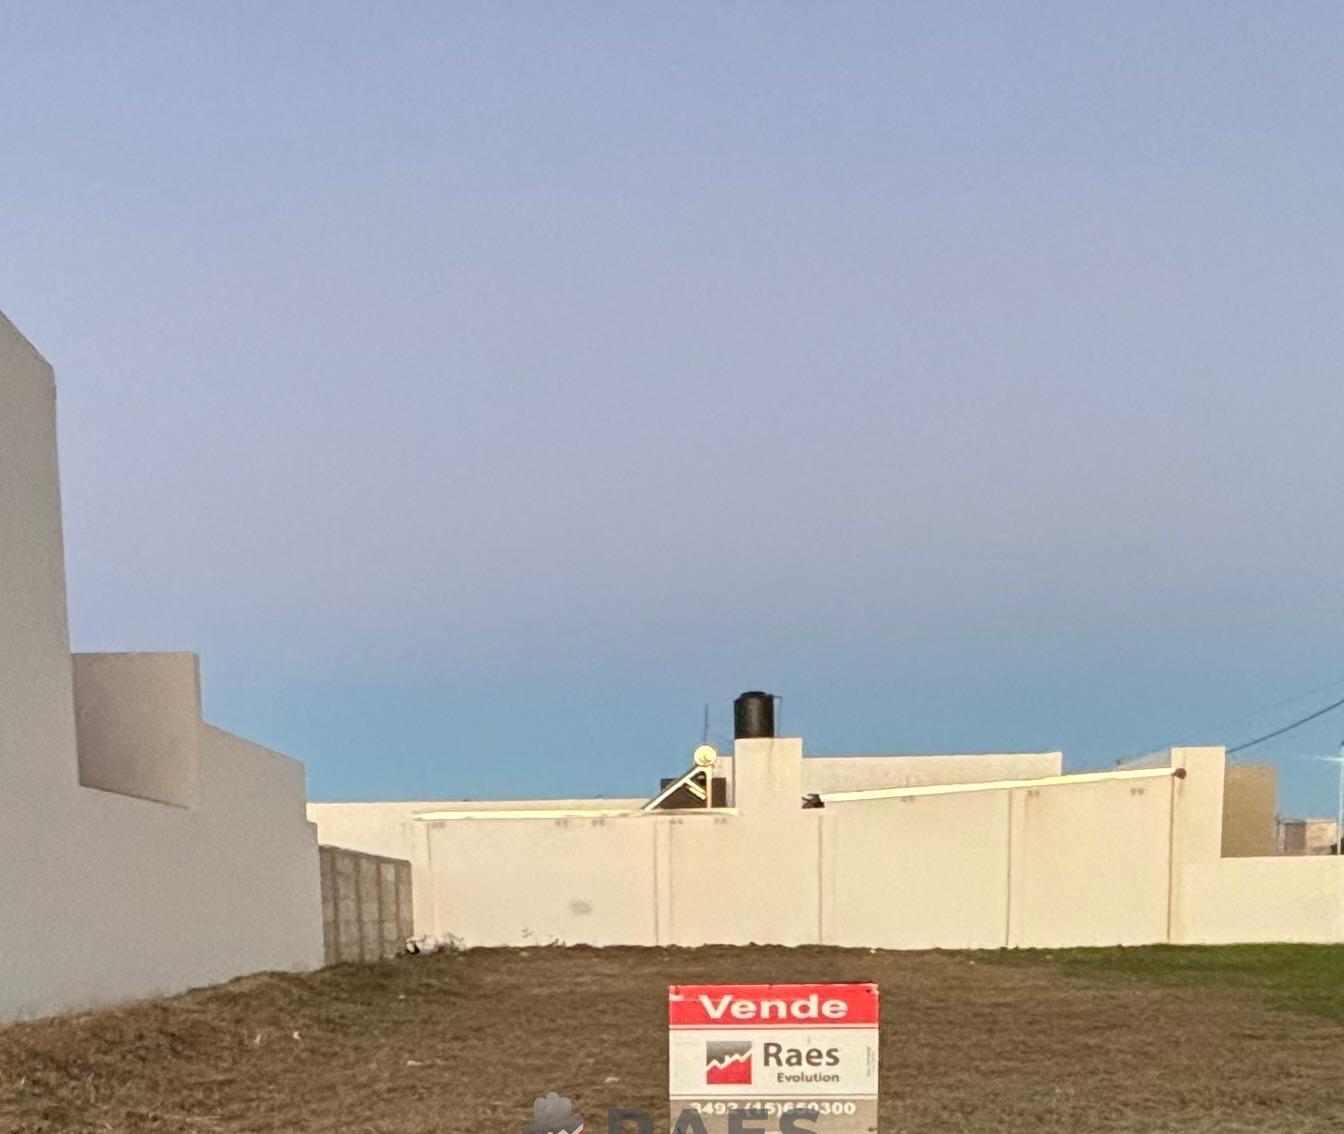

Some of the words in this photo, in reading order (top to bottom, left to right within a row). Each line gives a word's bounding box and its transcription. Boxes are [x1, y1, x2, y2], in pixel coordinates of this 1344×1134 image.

[699, 994, 848, 1019] Vende
[763, 1042, 840, 1067] Raes
[777, 1072, 839, 1083] Evolution
